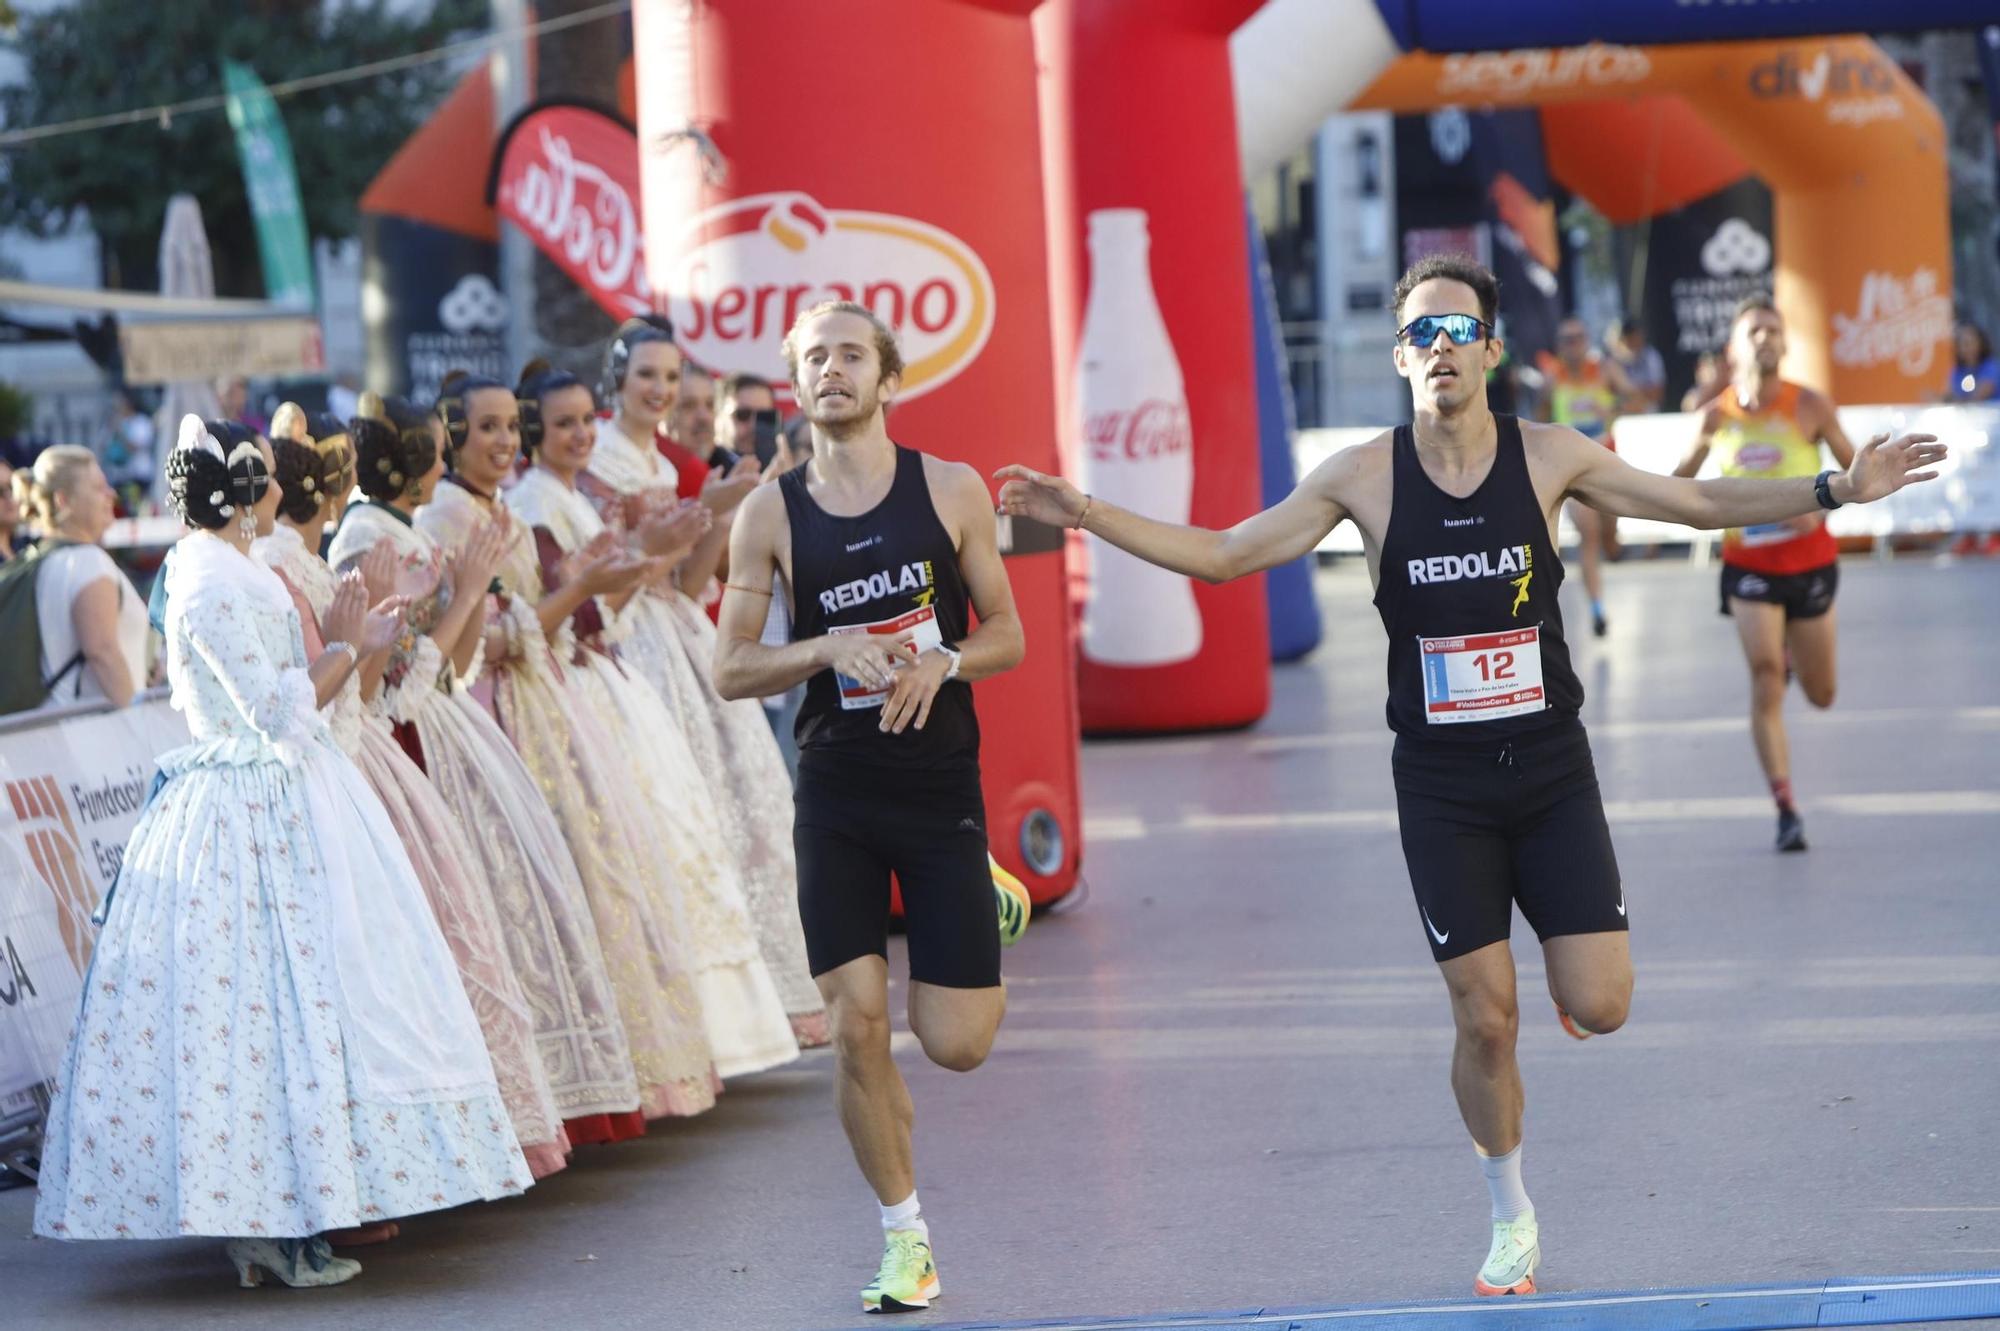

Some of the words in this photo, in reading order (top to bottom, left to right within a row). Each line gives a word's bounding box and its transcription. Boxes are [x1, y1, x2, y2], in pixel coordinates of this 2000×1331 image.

[1444, 517, 1474, 527] luanvi
[1408, 545, 1527, 585] REDOLAT
[1523, 543, 1533, 570] TEAM
[923, 560, 934, 585] TEAM
[819, 561, 928, 614] REDOLAT
[1472, 651, 1516, 682] 12
